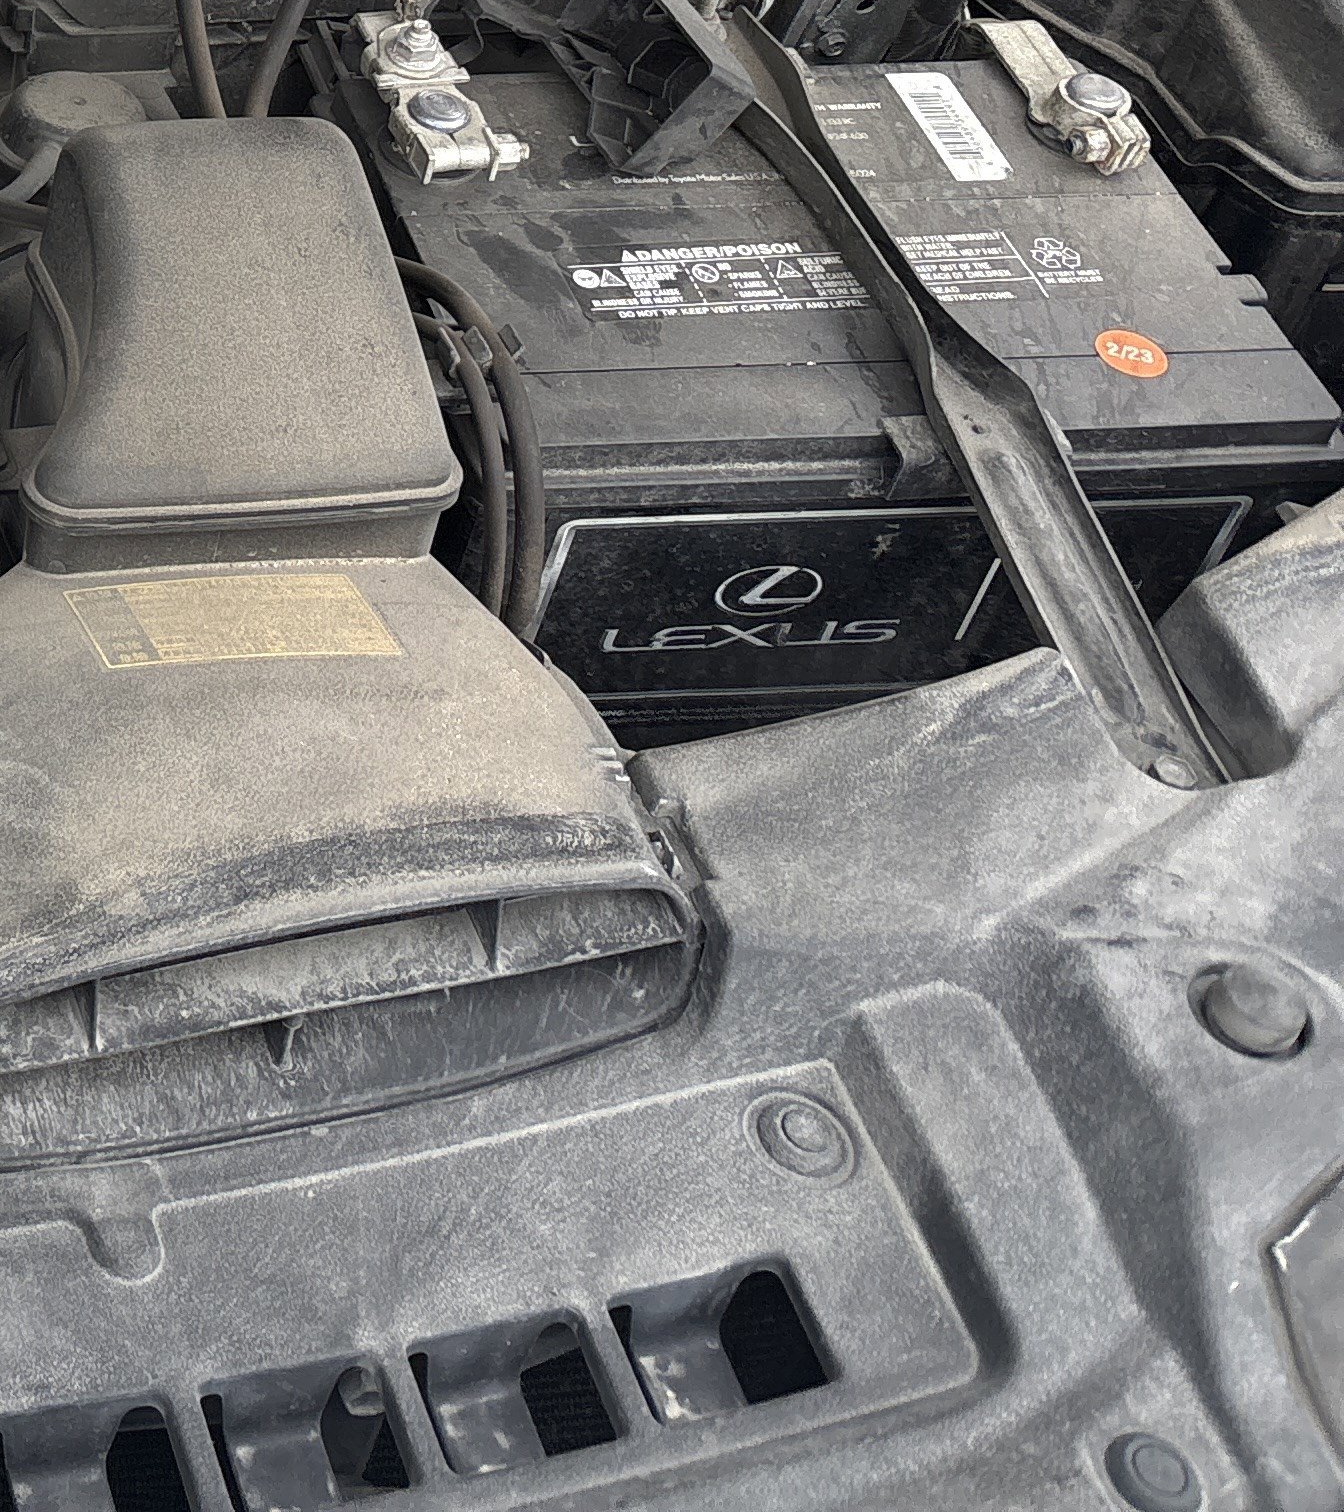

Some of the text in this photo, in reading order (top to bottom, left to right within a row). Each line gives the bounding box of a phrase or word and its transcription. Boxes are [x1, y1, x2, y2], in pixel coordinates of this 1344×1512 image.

[668, 174, 696, 183] Toyota
[635, 242, 803, 261] DANGER/POISON
[960, 248, 982, 257] HELP
[797, 256, 843, 265] SULFURIC
[803, 265, 825, 274] ACID
[939, 263, 958, 271] OUT
[959, 262, 971, 271] OF
[972, 261, 991, 270] THE
[624, 272, 678, 283] EXPLOSIVE
[727, 271, 762, 280] SPARKS
[807, 271, 856, 281] CAN CAUSE
[952, 271, 964, 280] OF
[1037, 268, 1101, 278] BATTERY MUST
[1059, 275, 1103, 284] RECYCLED
[733, 280, 769, 289] FLAMES
[634, 288, 681, 298] CAN CAUSE
[640, 297, 653, 305] OR
[618, 310, 635, 319] DO
[636, 309, 660, 318] NOT
[681, 307, 709, 316] KEEP
[710, 305, 739, 314] VENT
[741, 303, 771, 313] CAPS
[772, 302, 803, 311] TIGHT
[806, 301, 828, 310] AND
[1105, 341, 1155, 364] 2/23
[602, 619, 900, 652] LEXUS
